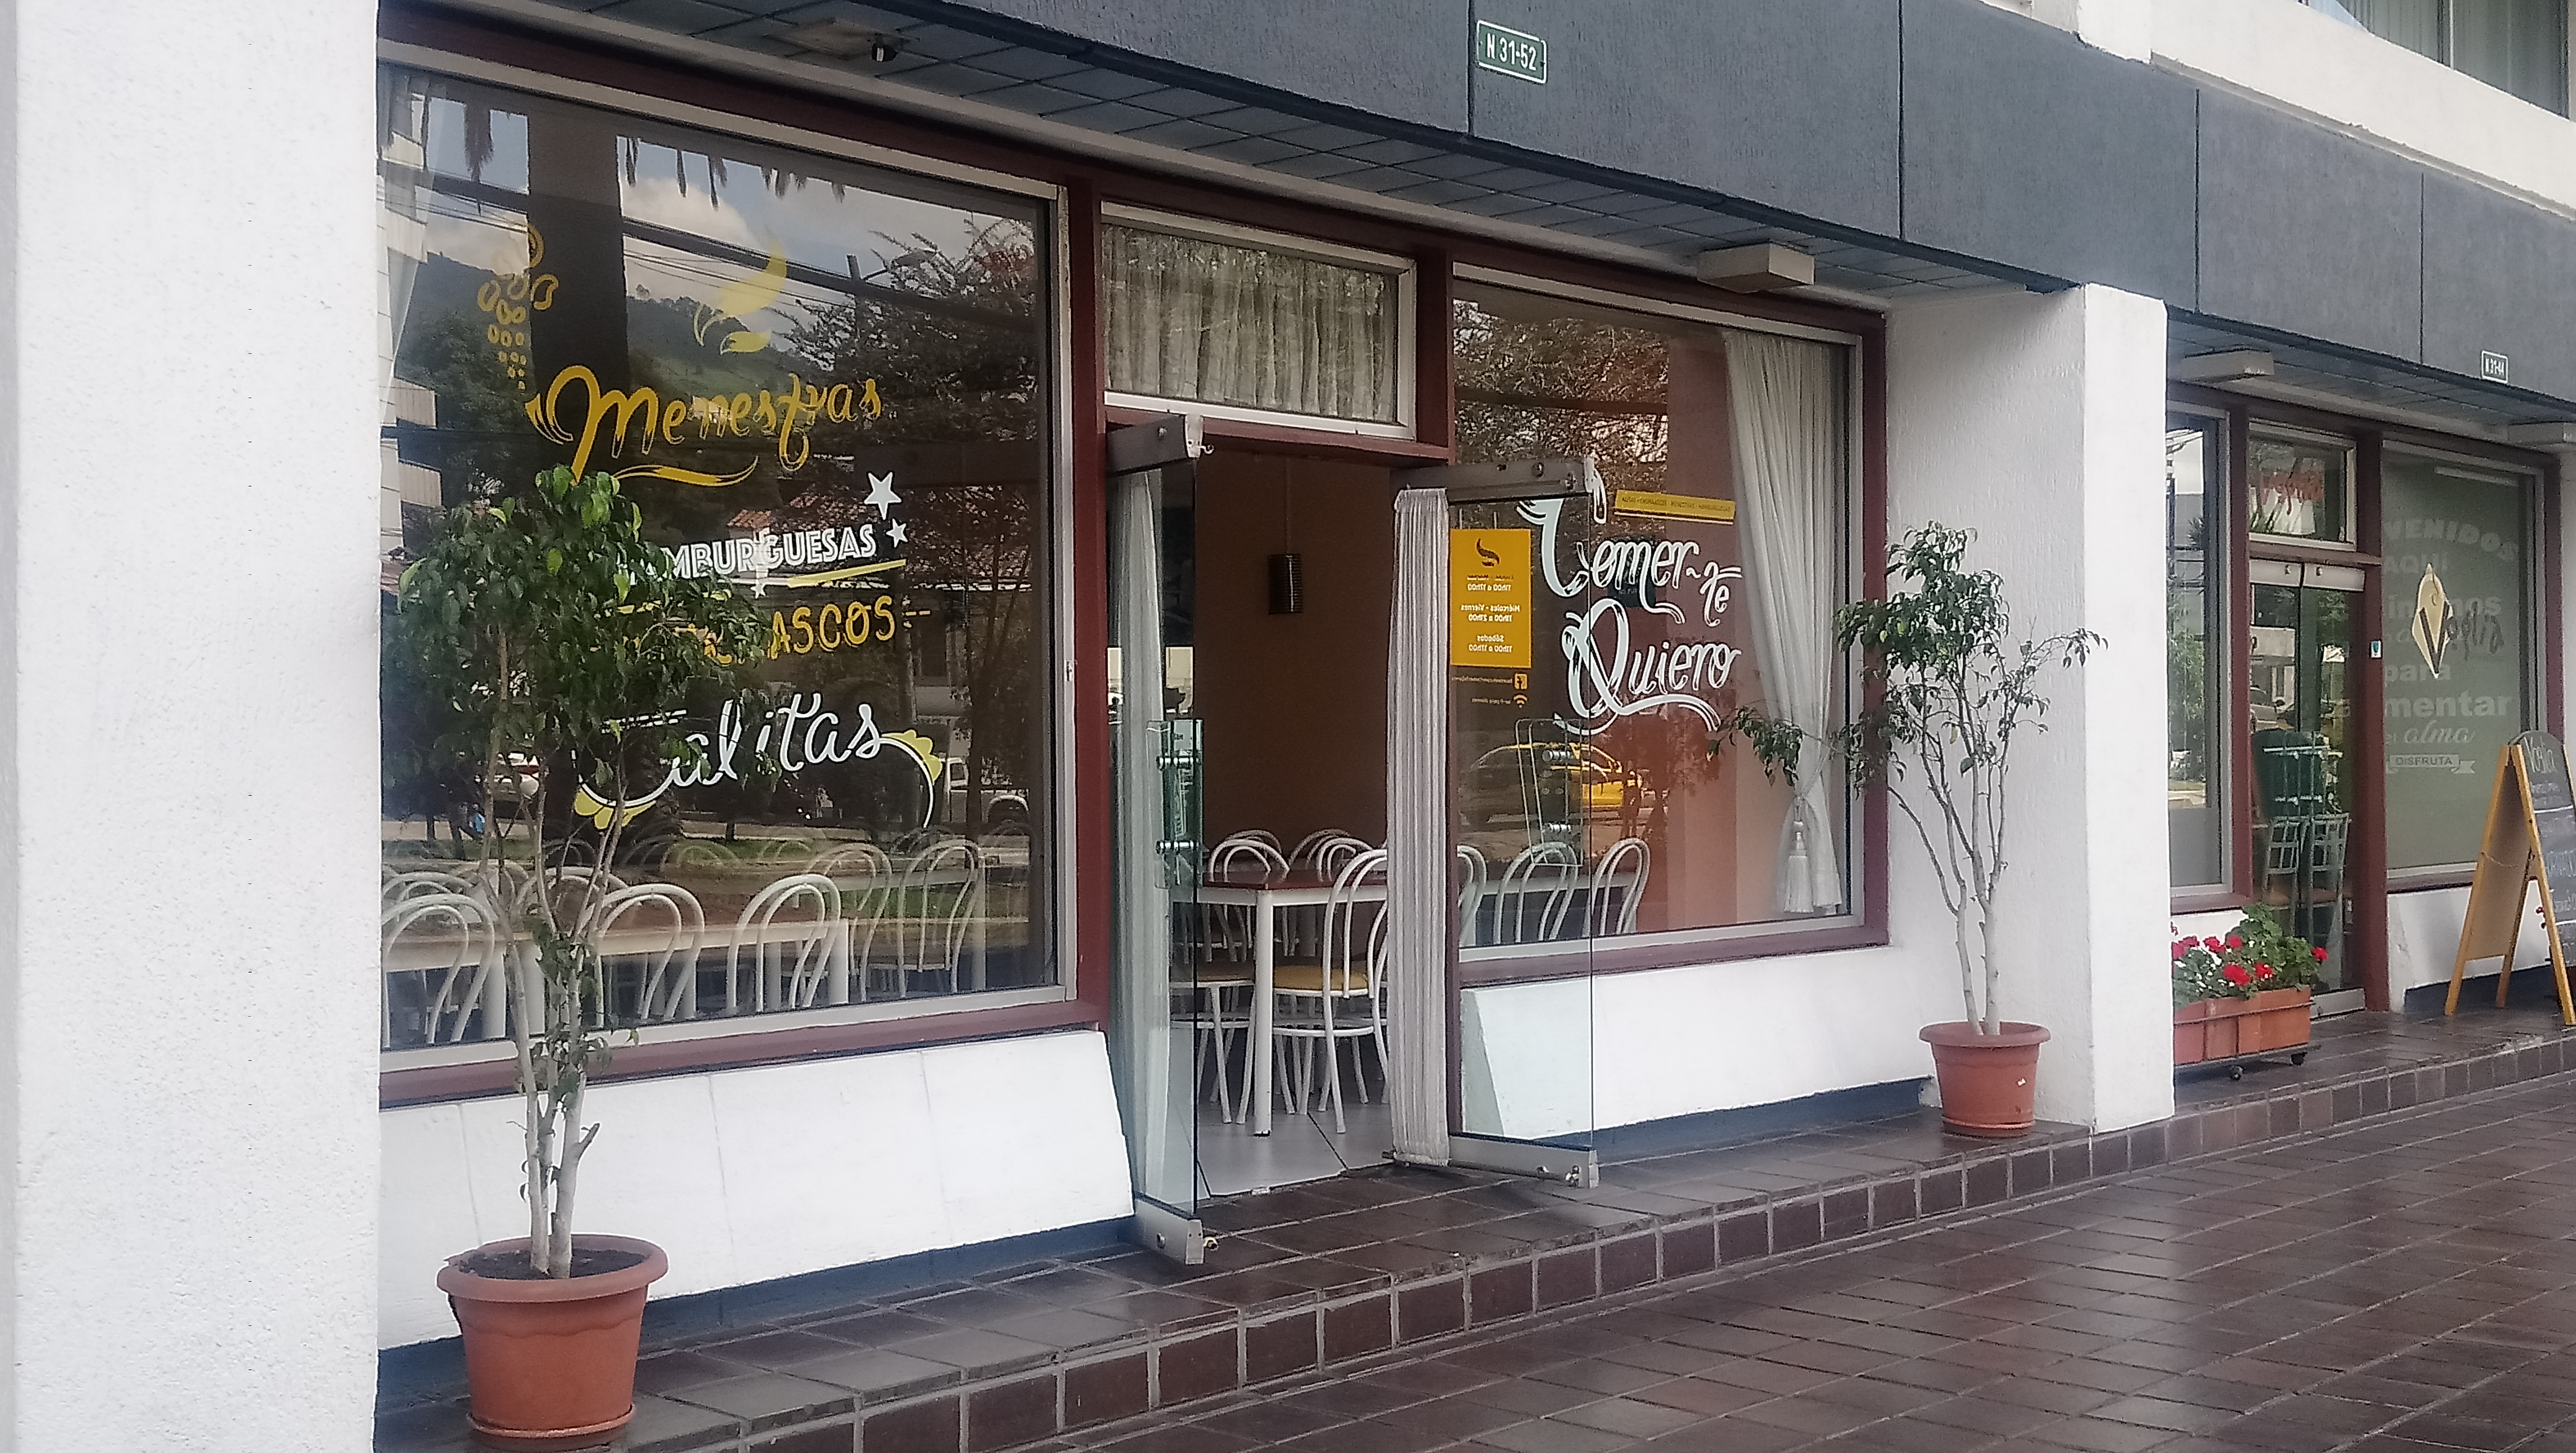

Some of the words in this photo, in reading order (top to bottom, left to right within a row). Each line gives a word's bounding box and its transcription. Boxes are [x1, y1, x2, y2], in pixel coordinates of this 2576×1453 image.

[1487, 33, 1495, 59] N
[1499, 37, 1537, 71] 31-52
[525, 365, 882, 485] Menestras
[616, 523, 877, 586] MBURGUESAS
[1553, 598, 1742, 735] Quiero
[2396, 757, 2452, 766] DISFRUTA
